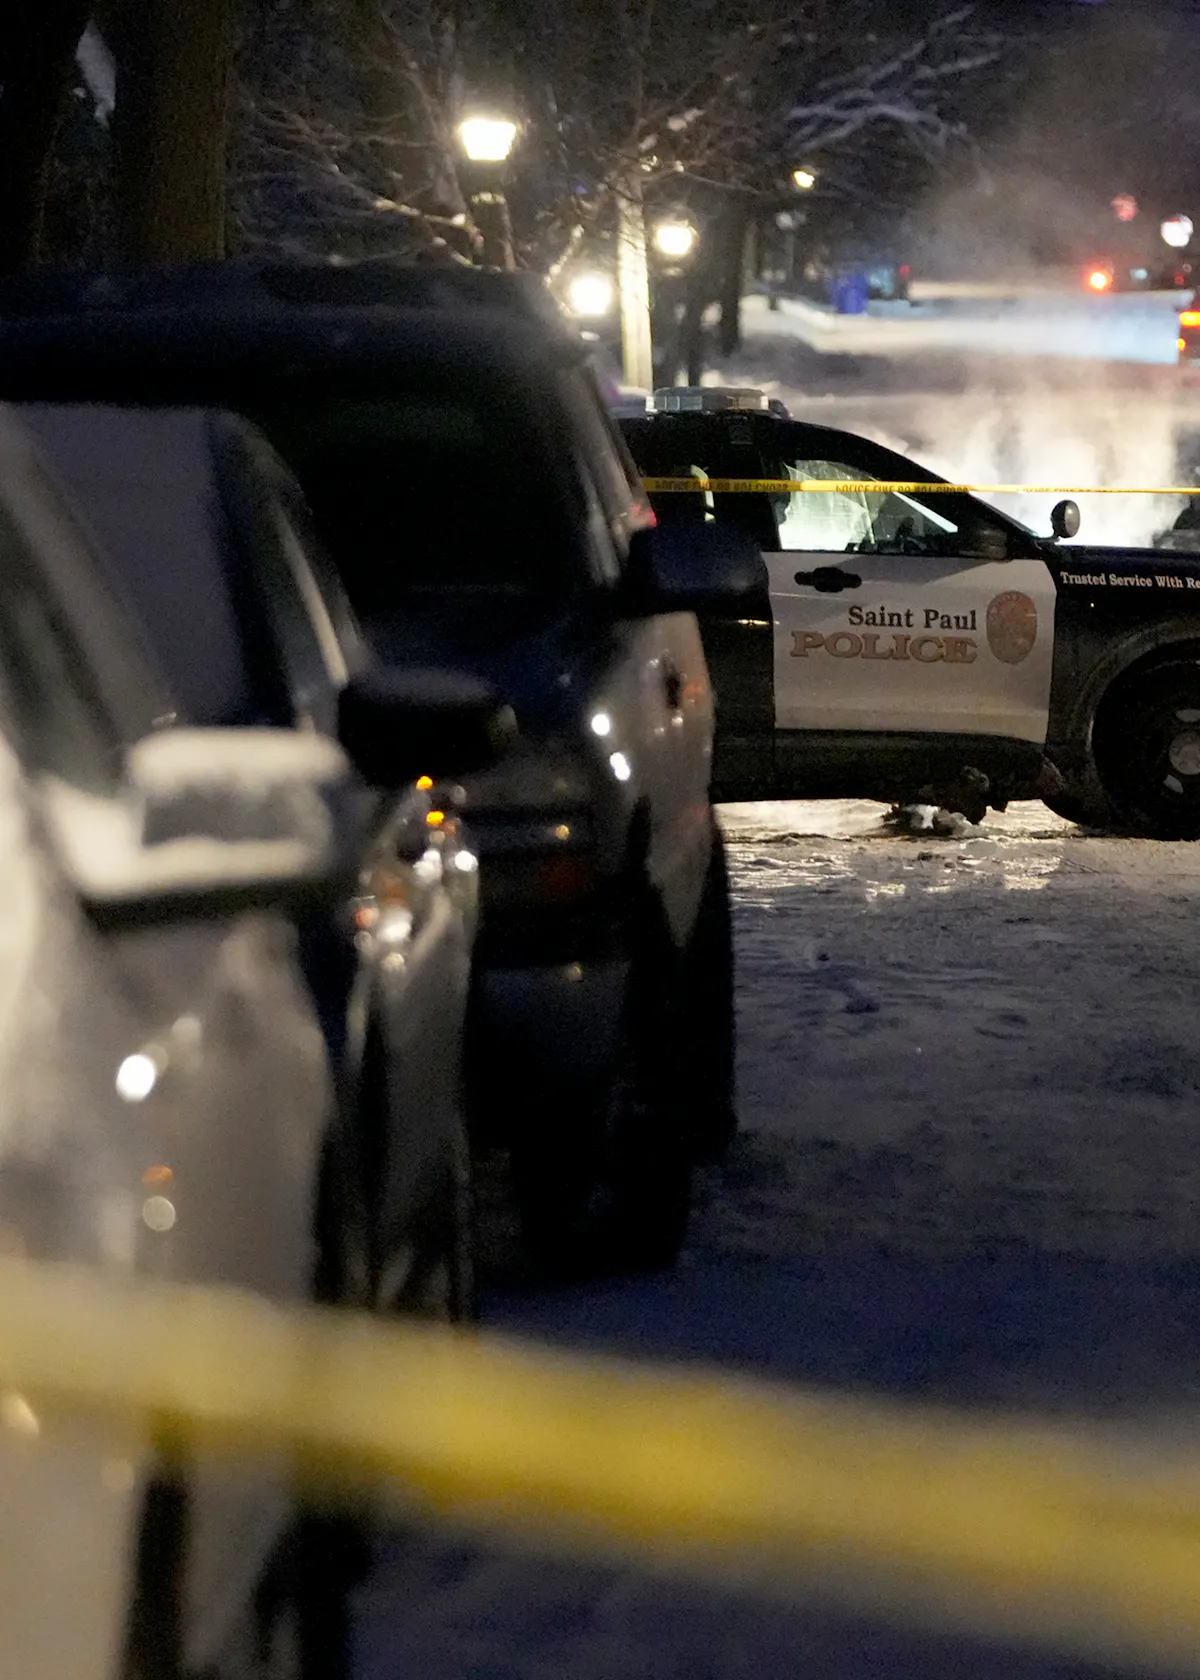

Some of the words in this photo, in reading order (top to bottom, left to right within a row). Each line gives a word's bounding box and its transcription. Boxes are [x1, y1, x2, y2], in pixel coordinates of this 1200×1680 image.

[1060, 571, 1106, 585] Trusted
[1109, 573, 1153, 587] Service
[1154, 575, 1184, 589] With
[849, 605, 914, 628] Saint
[923, 608, 977, 630] Paul
[790, 630, 978, 664] POLICE
